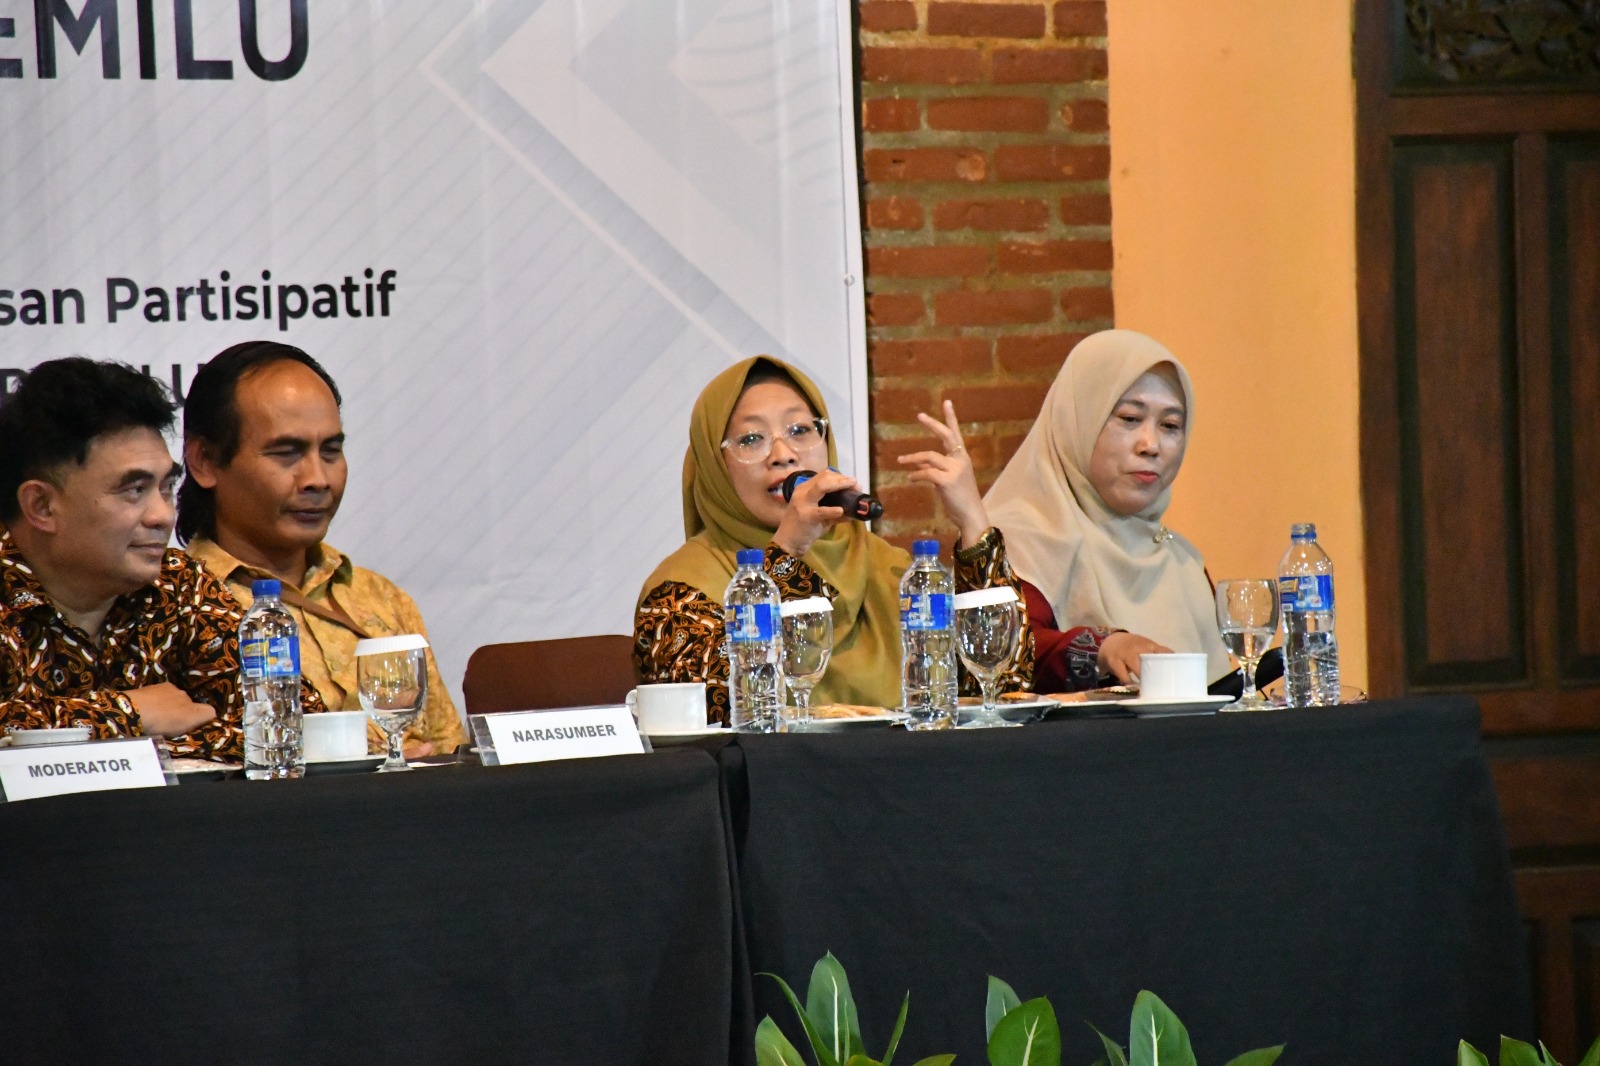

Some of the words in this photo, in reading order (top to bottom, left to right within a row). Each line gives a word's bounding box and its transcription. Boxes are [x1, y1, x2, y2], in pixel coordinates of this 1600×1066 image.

[0, 288, 85, 326] san
[106, 268, 397, 331] Partisipatif
[512, 724, 617, 743] NARASUMBER
[28, 758, 132, 778] MODERATOR
